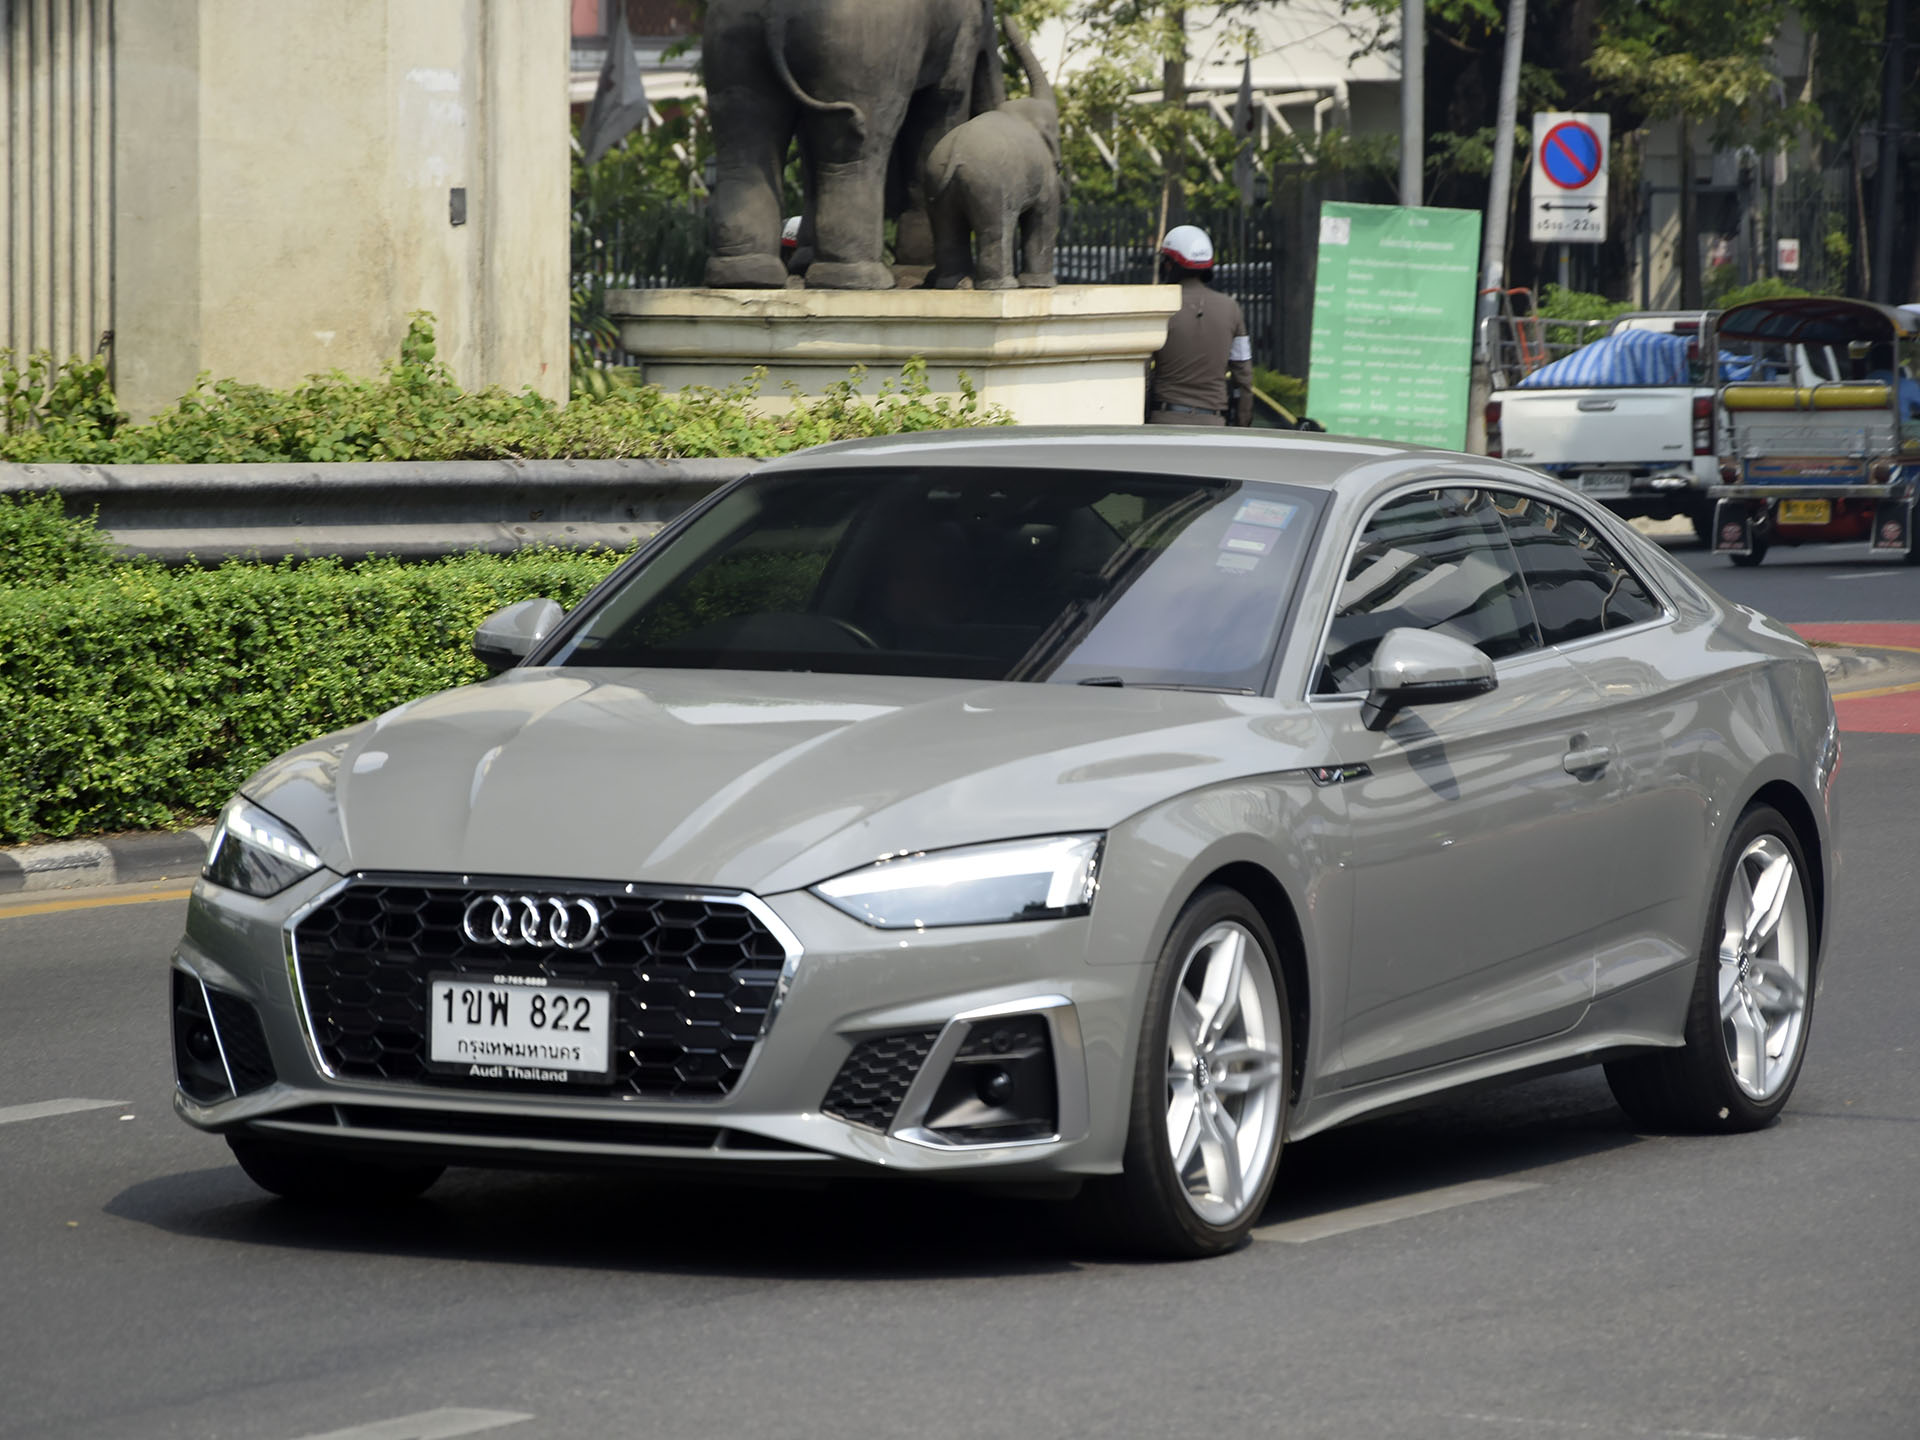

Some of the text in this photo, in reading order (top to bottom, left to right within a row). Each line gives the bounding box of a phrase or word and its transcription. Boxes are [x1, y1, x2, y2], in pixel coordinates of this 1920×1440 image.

[529, 994, 591, 1032] 822
[457, 1039, 581, 1060] กรุงเทพมหานคร
[469, 1064, 568, 1082] Audi Thailand
